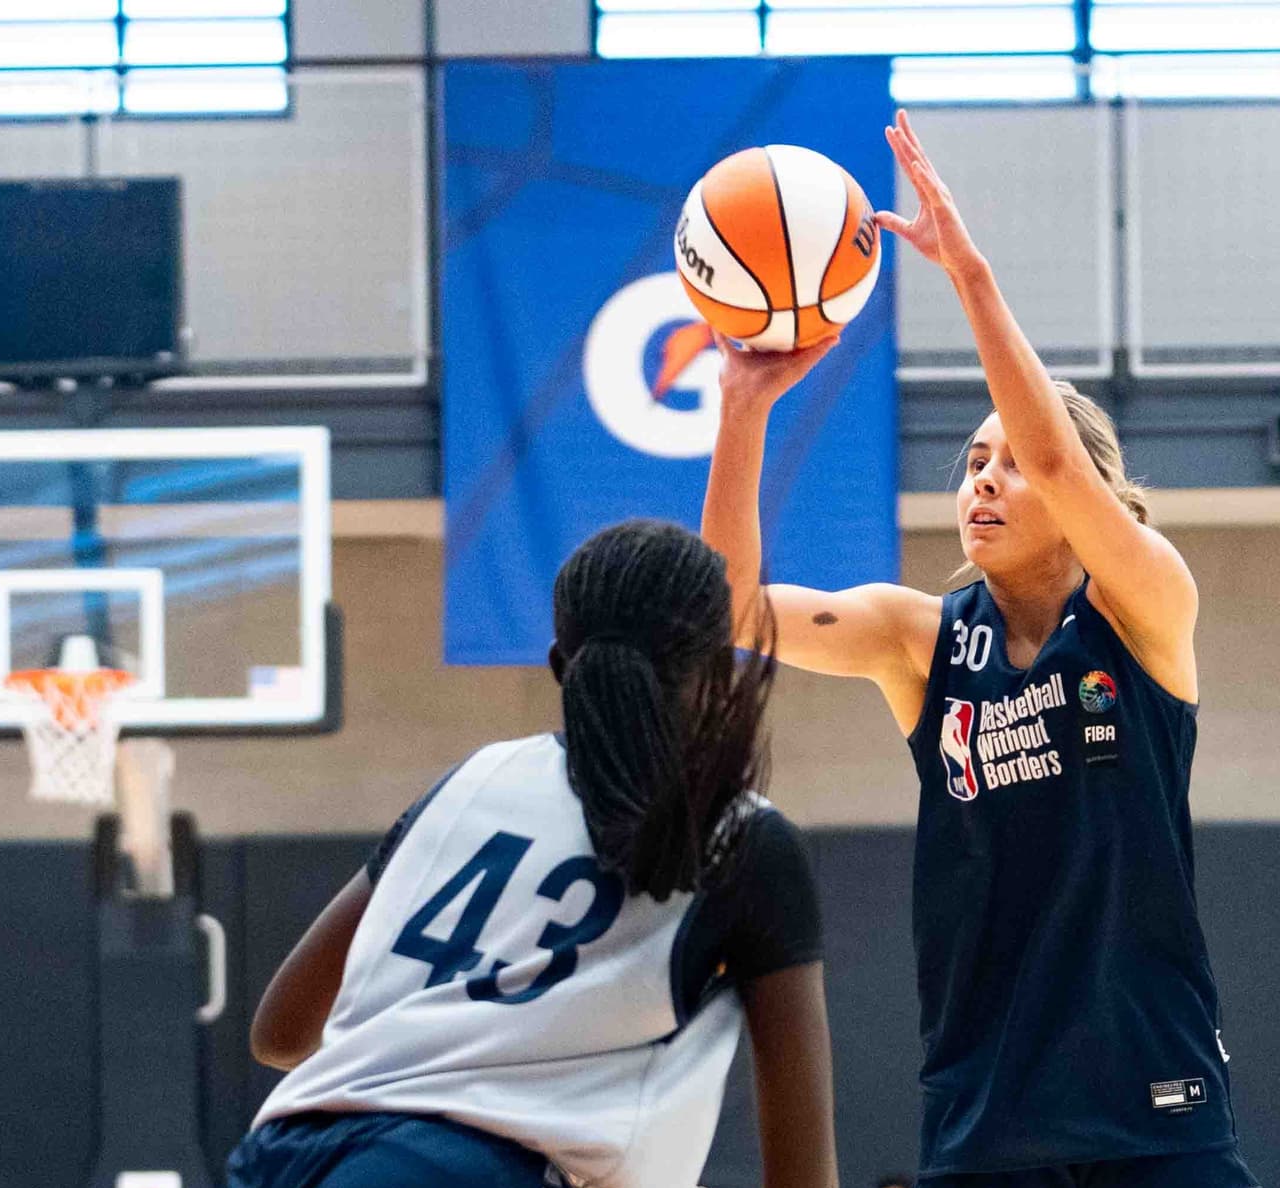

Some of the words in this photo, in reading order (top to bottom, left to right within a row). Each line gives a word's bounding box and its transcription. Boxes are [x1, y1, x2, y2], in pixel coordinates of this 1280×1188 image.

[950, 618, 993, 672] 30
[979, 673, 1067, 733] Basketball
[976, 714, 1051, 764] Without
[1084, 725, 1116, 744] FIBA
[982, 750, 1062, 791] Borders
[391, 831, 626, 1005] 43
[1189, 1084, 1201, 1097] M
